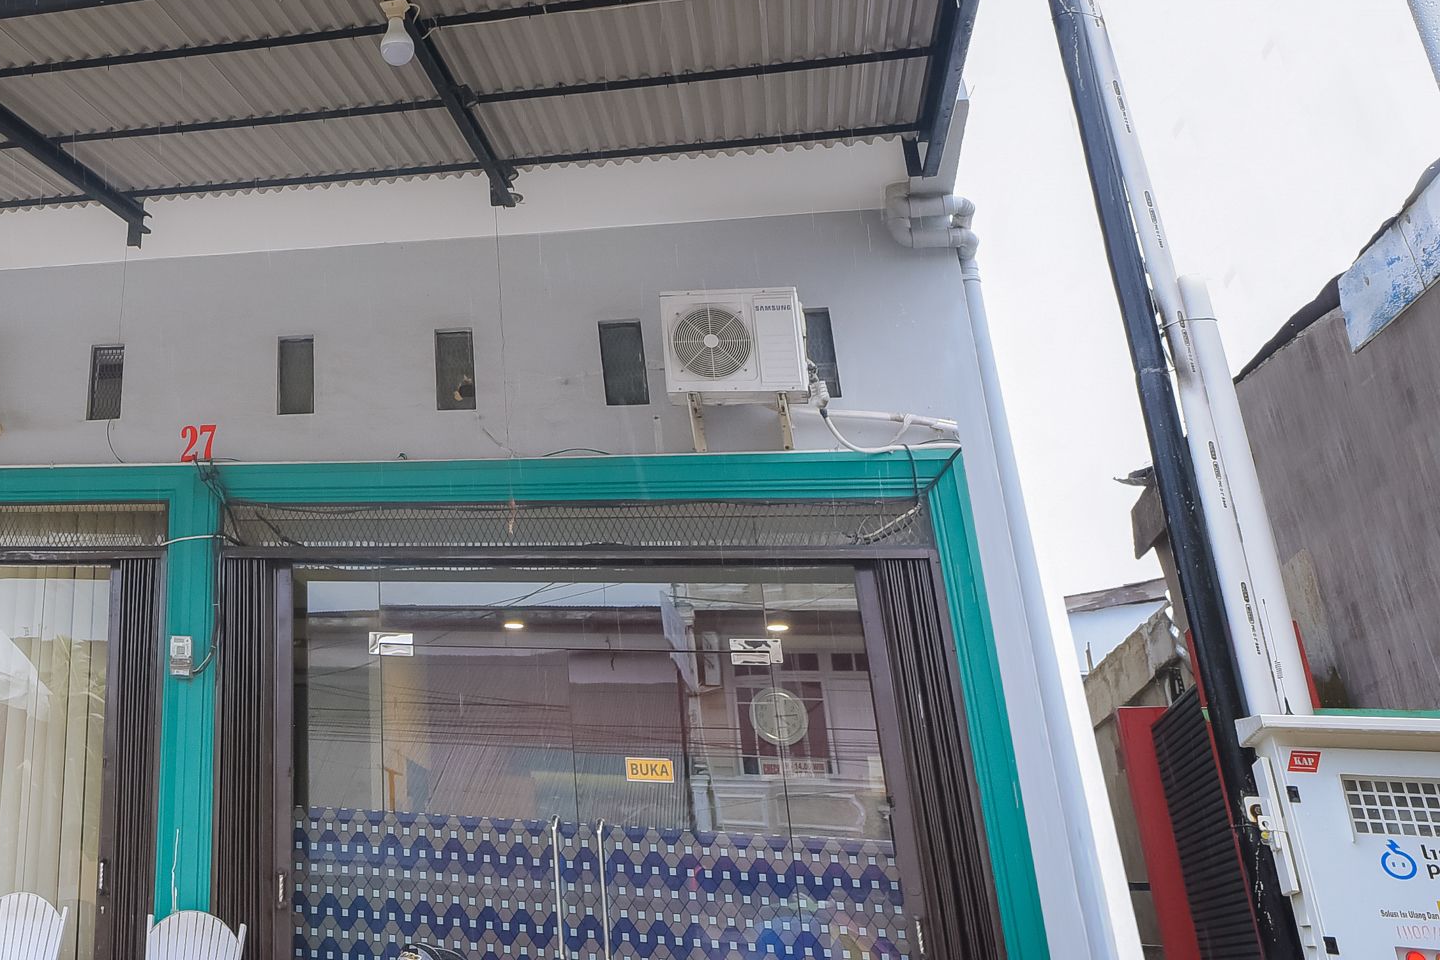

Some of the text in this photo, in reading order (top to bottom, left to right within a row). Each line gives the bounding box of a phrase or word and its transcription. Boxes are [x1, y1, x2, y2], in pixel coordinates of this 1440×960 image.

[181, 425, 216, 462] 27
[1293, 756, 1315, 766] KAP
[630, 763, 669, 776] BUKA
